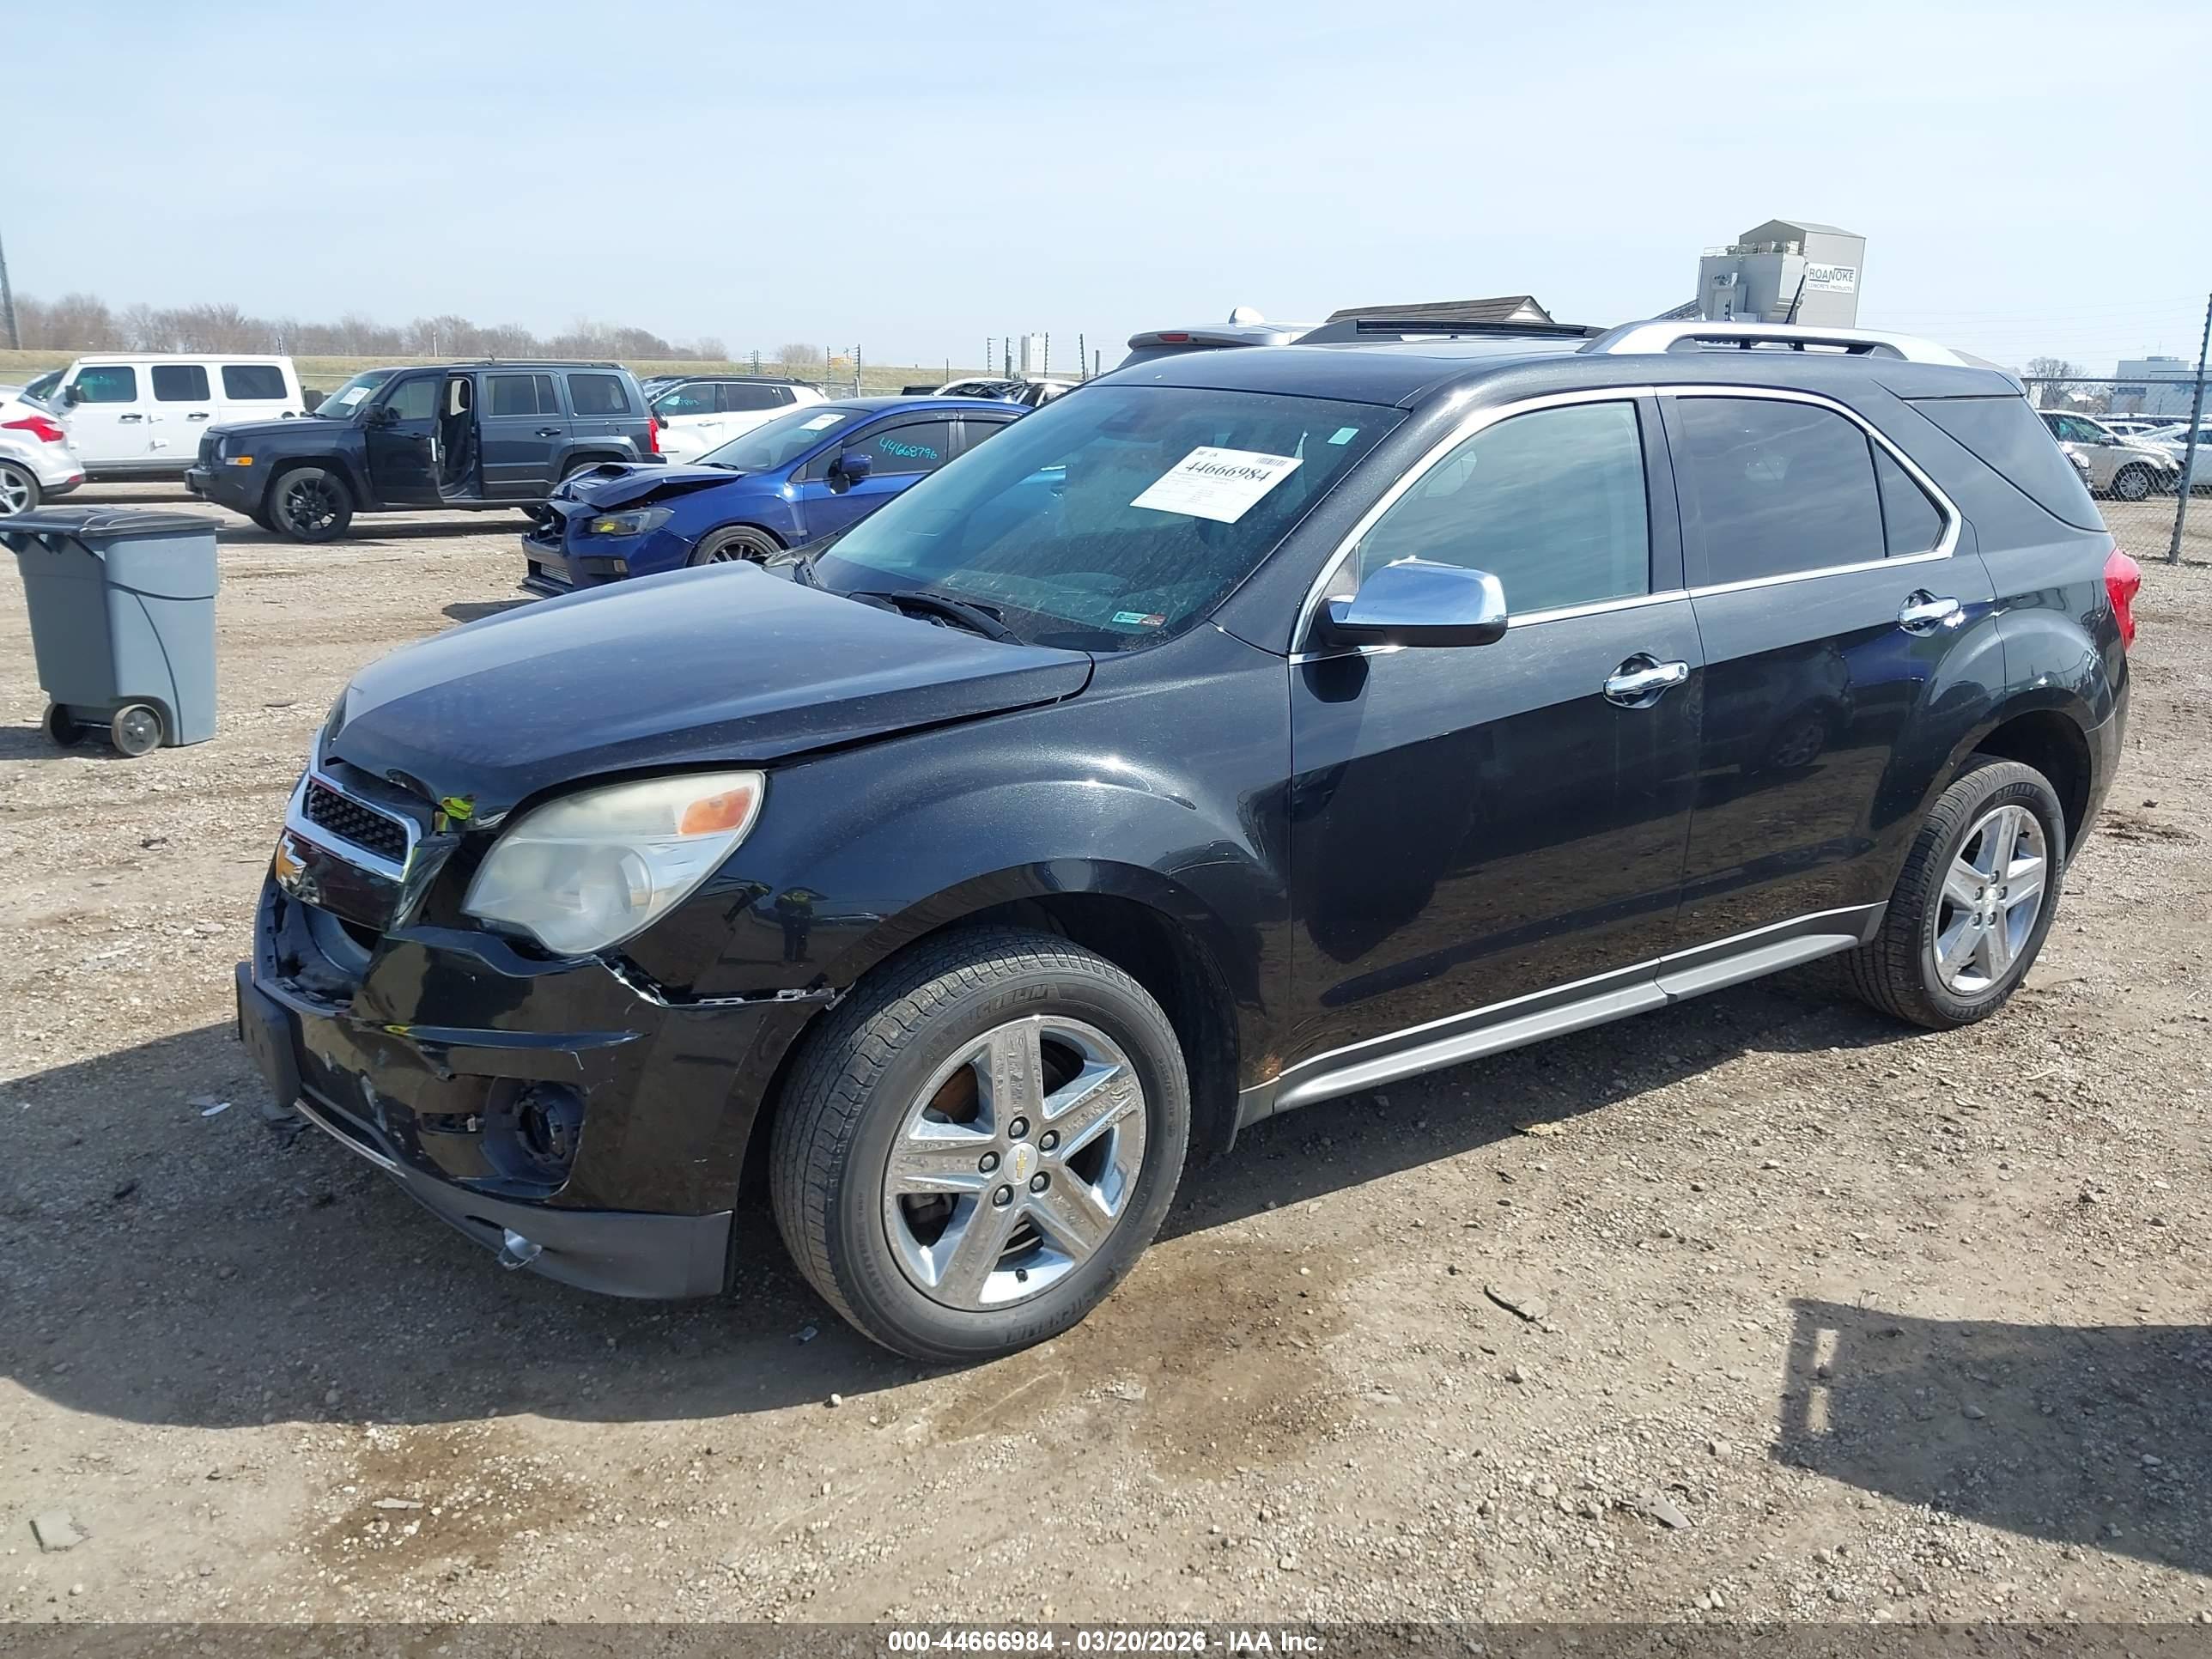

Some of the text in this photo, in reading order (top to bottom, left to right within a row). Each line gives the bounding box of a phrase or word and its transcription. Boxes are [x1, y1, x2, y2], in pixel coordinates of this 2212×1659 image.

[1809, 268, 1854, 283] ROANOKE
[879, 436, 938, 459] 44668796
[1184, 461, 1273, 482] 44666984
